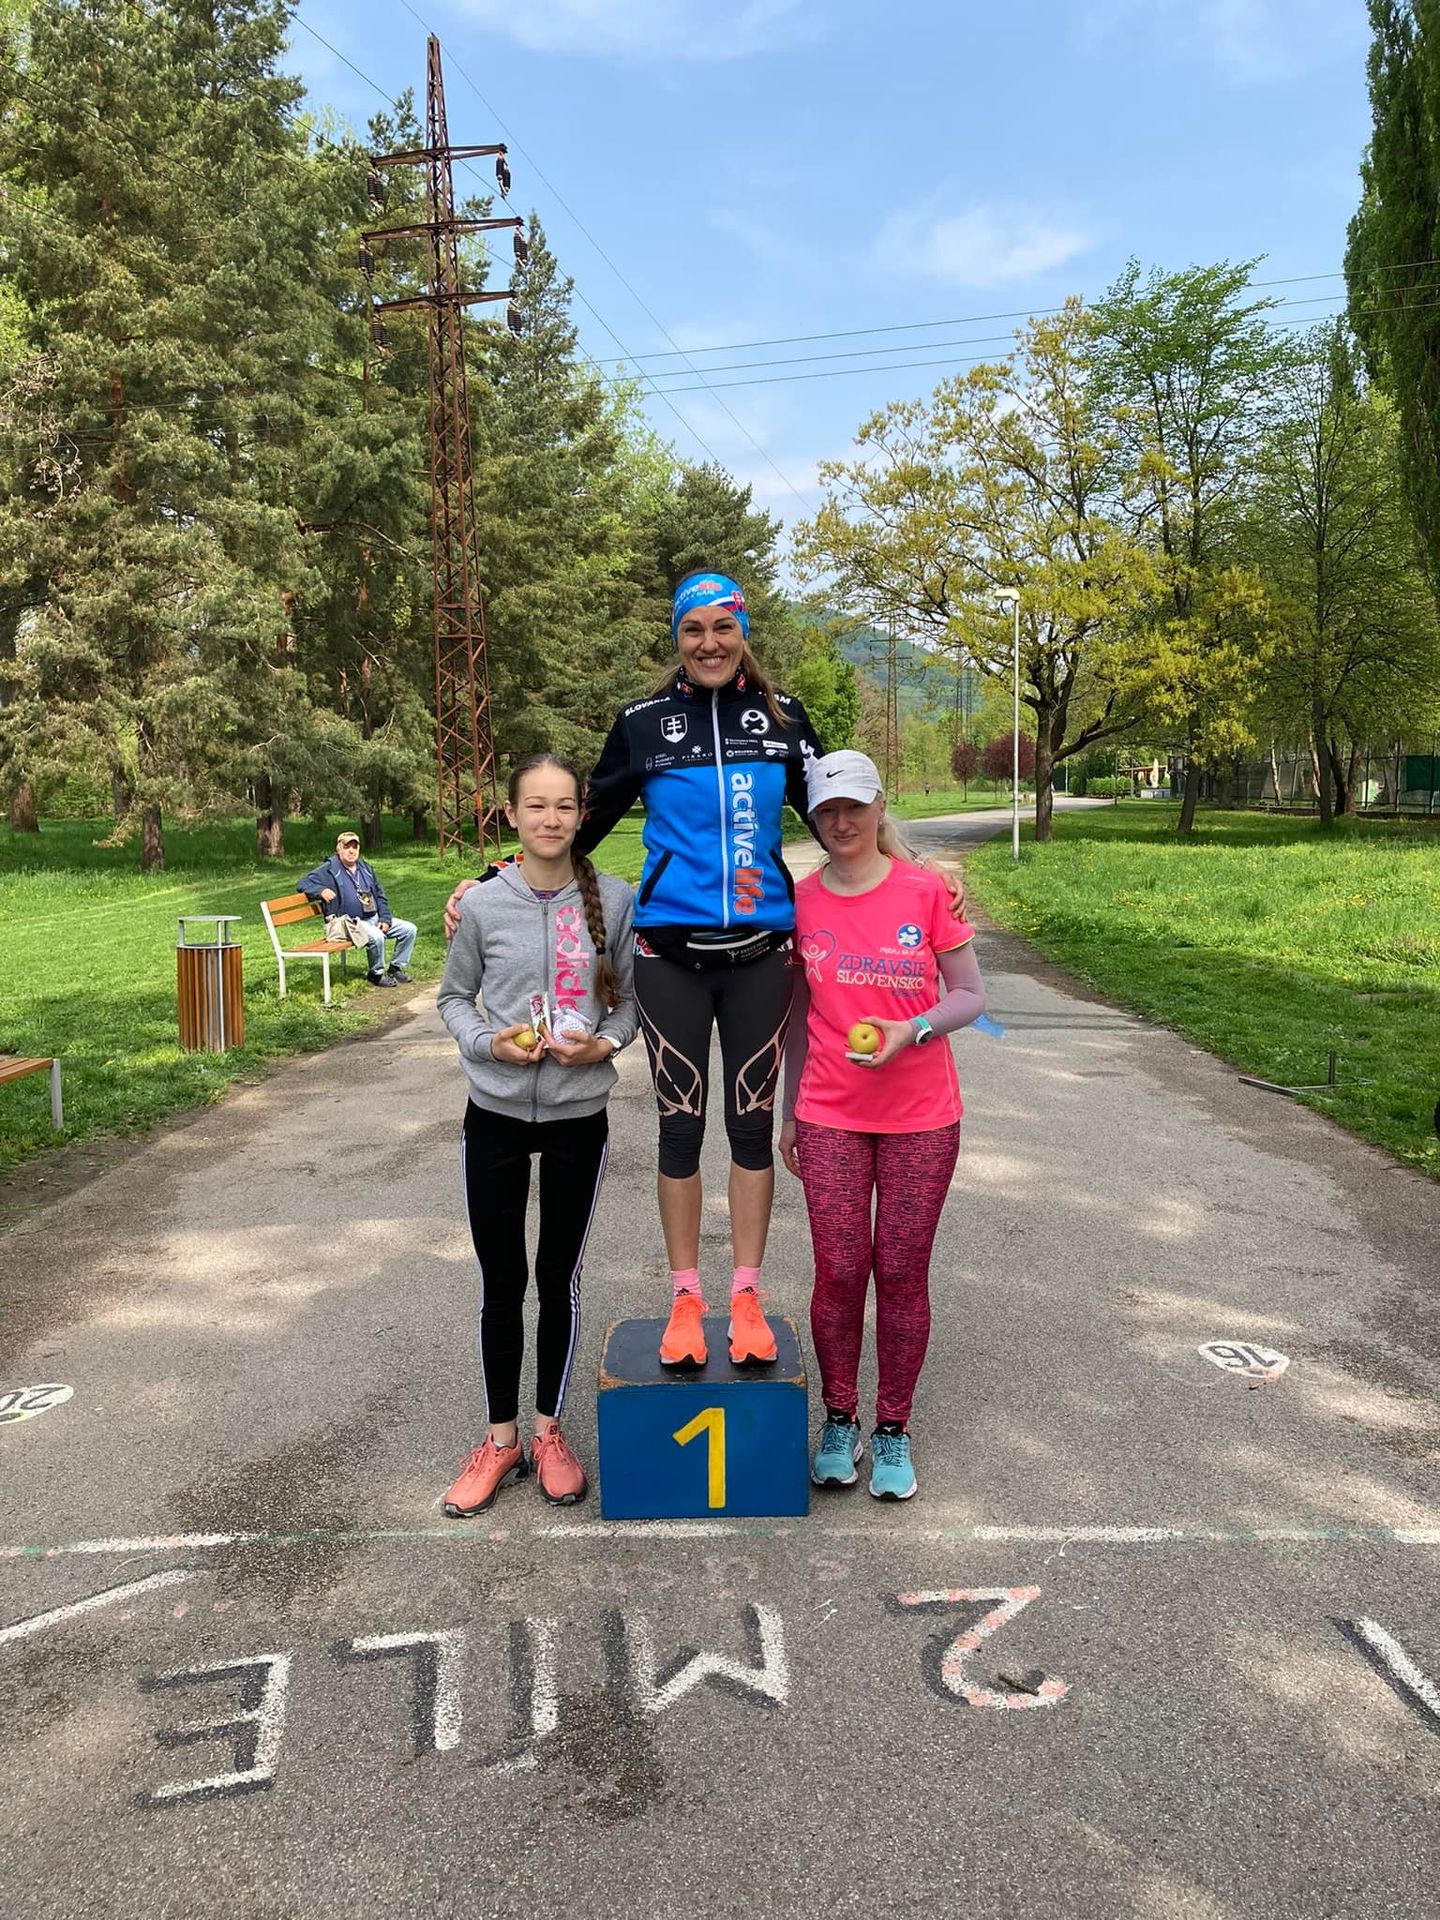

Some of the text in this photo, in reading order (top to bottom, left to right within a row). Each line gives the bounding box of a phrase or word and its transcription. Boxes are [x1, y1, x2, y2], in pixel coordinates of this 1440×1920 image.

[728, 771, 766, 915] activelife
[836, 969, 926, 989] SLOVENSKO
[672, 1407, 726, 1509] 1
[888, 1586, 1071, 1708] 2
